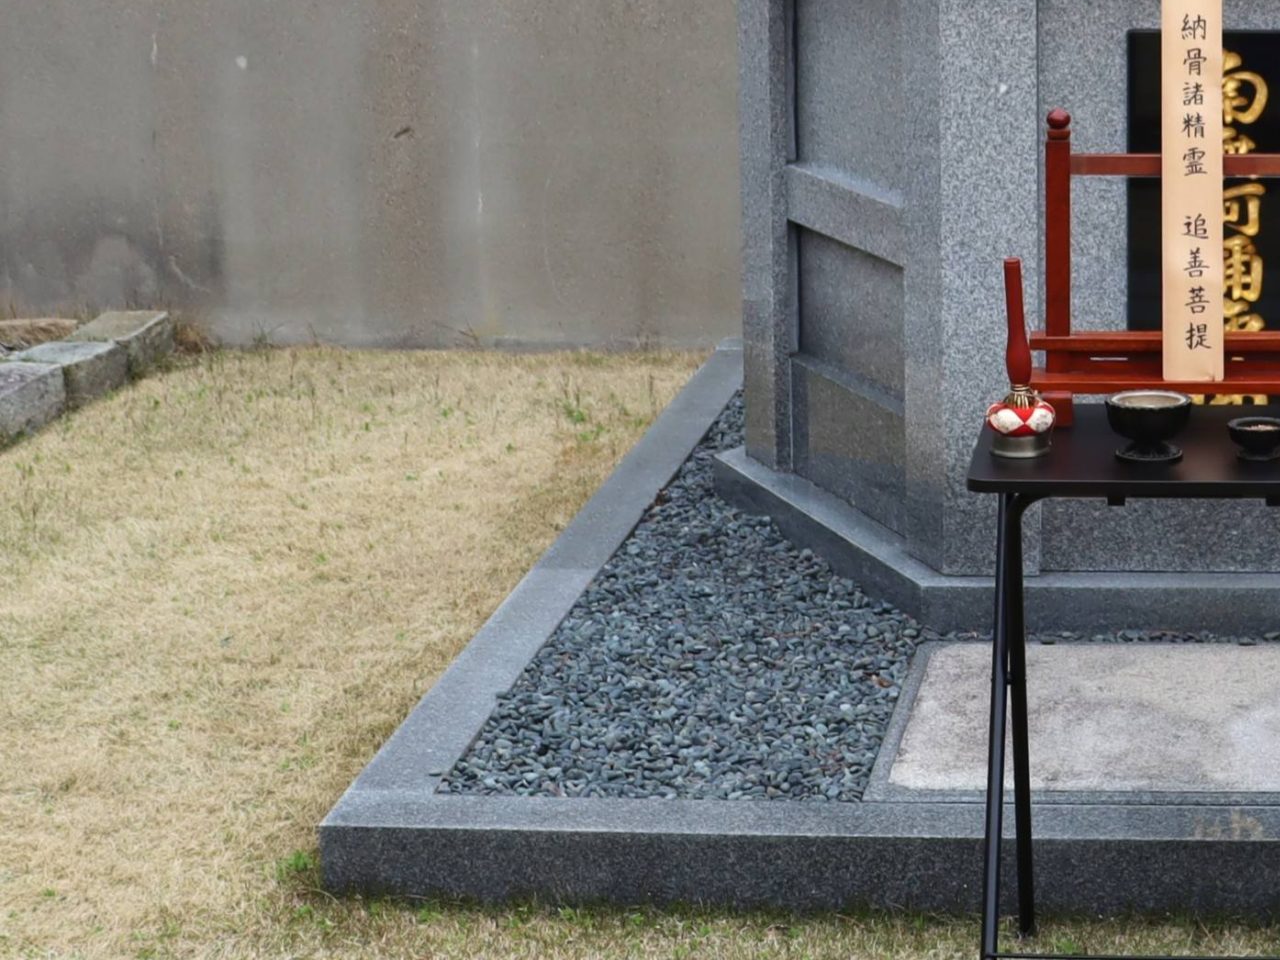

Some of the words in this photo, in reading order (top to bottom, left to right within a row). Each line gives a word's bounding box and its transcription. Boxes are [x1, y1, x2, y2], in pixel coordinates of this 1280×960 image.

[1180, 13, 1208, 178] 納骨諸精霊
[1181, 213, 1212, 351] 追善菩提
